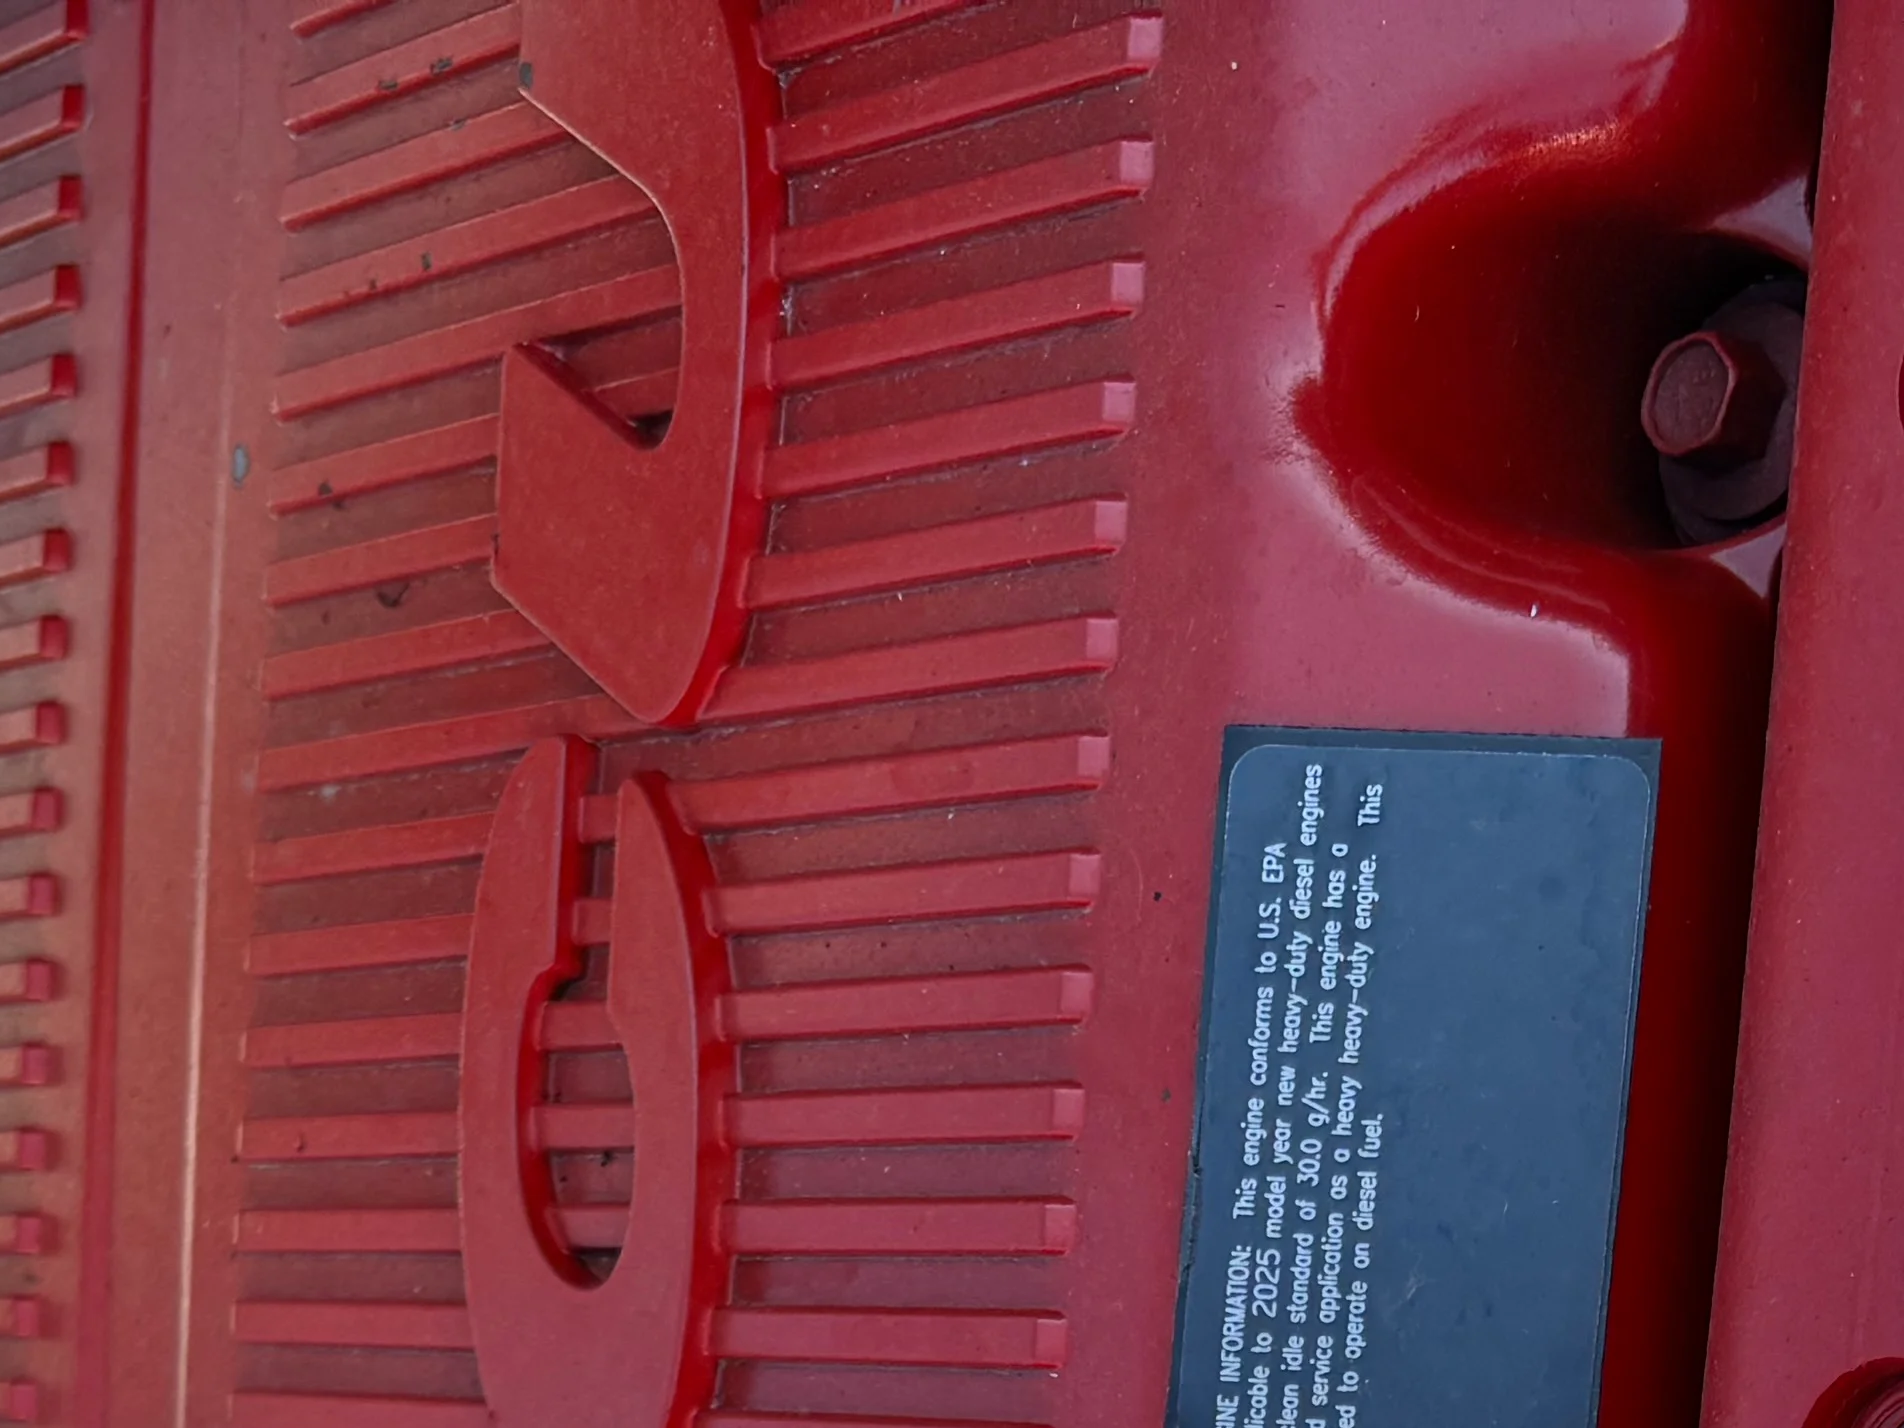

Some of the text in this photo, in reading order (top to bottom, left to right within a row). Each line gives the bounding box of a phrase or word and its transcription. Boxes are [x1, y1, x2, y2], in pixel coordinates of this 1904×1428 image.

[1296, 763, 1324, 846] engines
[1356, 783, 1383, 827] This
[1260, 841, 1287, 883] EPA
[1330, 842, 1349, 857] a
[1287, 857, 1314, 920] diesel
[1320, 868, 1346, 908] has
[1351, 853, 1380, 930] engine.
[1256, 896, 1282, 939] U.S.
[1253, 950, 1277, 973] to
[1316, 919, 1345, 991] engine
[1276, 929, 1314, 1053] heavy-duty
[1336, 940, 1375, 1064] heavy-duty
[1246, 985, 1274, 1086] conforms
[1308, 1001, 1335, 1043] This
[1276, 1064, 1296, 1106] new
[1300, 1070, 1331, 1127] g/hr.
[1330, 1074, 1363, 1136] heavy
[1239, 1096, 1268, 1166] engine
[1272, 1117, 1294, 1164] year
[1332, 1147, 1351, 1163] a
[1356, 1112, 1384, 1158] fuel.
[1295, 1137, 1323, 1187] 30.0
[1329, 1173, 1348, 1200] as
[1231, 1176, 1258, 1219] This
[1262, 1174, 1287, 1238] model
[1293, 1198, 1317, 1221] of
[1350, 1170, 1378, 1231] diesel
[1285, 1231, 1314, 1324] standard
[1316, 1211, 1344, 1324] application
[1352, 1241, 1371, 1269] on
[1250, 1247, 1281, 1318] 2025
[1218, 1243, 1252, 1382] INFORMATION:
[1343, 1279, 1368, 1359] operate
[1249, 1331, 1273, 1353] to
[1279, 1334, 1305, 1371] idle
[1308, 1334, 1334, 1406] service
[1335, 1370, 1359, 1392] to
